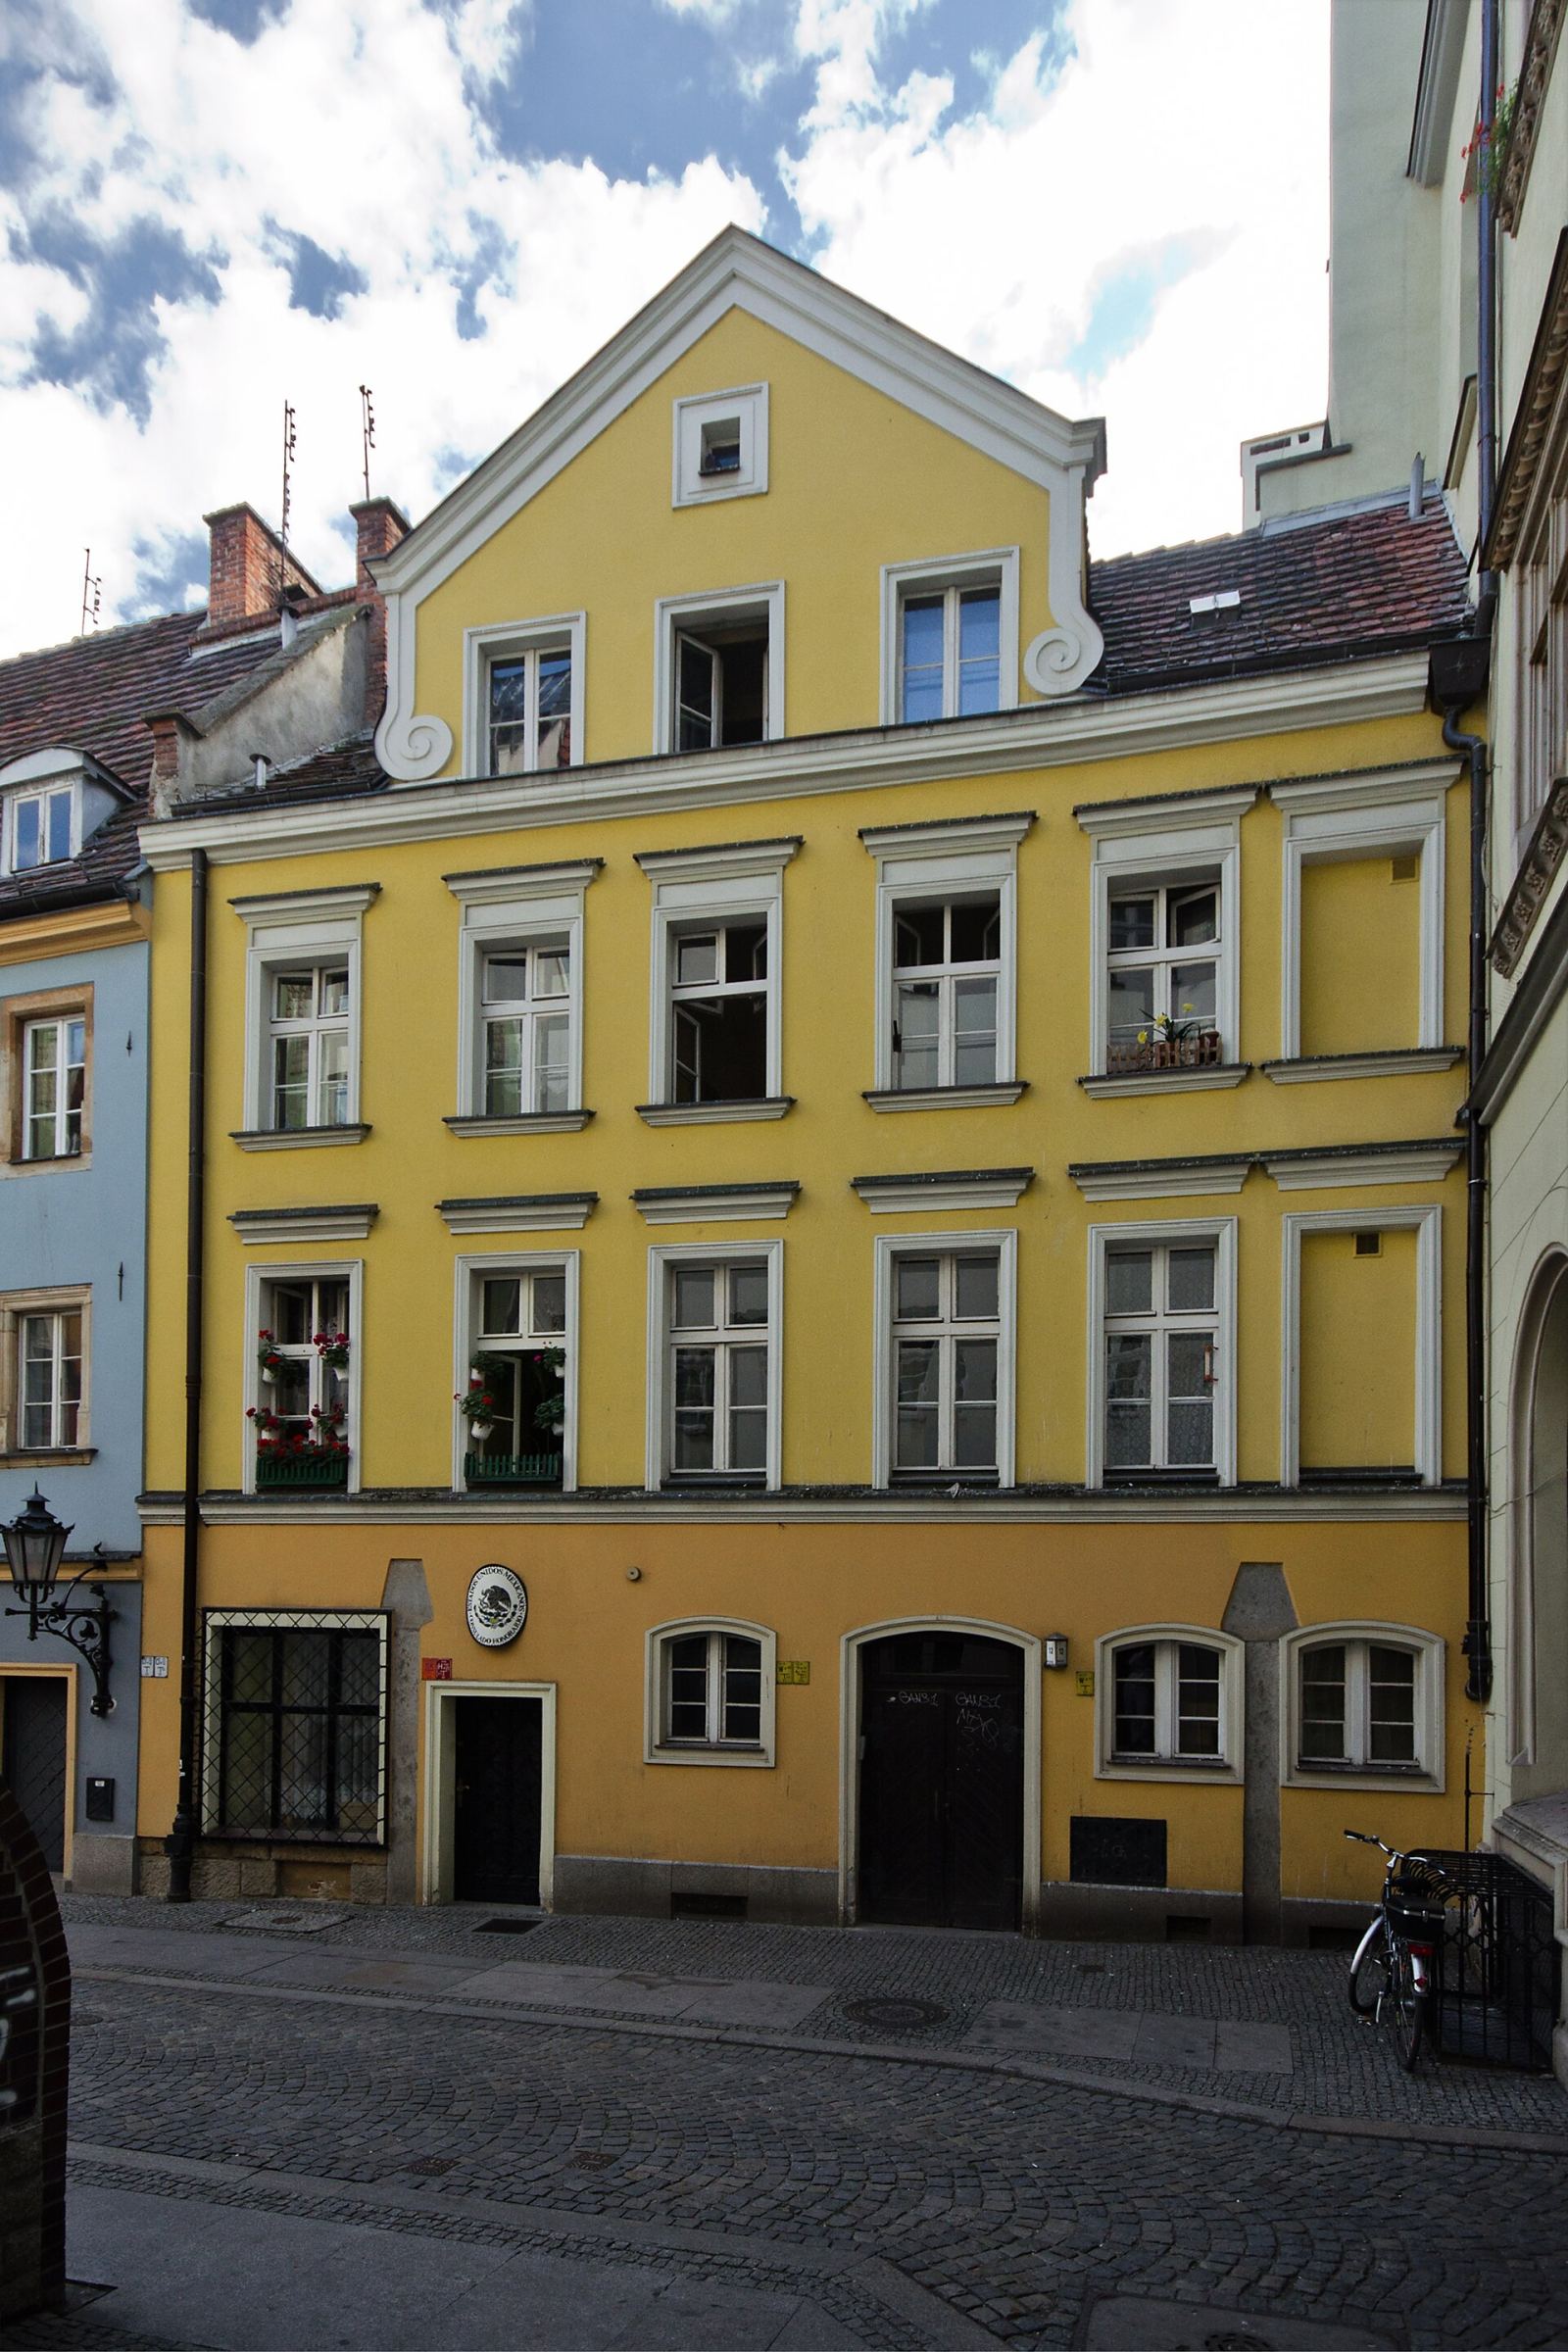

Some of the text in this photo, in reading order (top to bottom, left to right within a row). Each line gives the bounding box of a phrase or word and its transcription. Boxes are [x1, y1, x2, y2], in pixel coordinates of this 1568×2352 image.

[467, 1567, 525, 1613] ESTADOS UNIDOS MEXICANOS
[469, 1615, 523, 1644] CONSULADO HONORARIO
